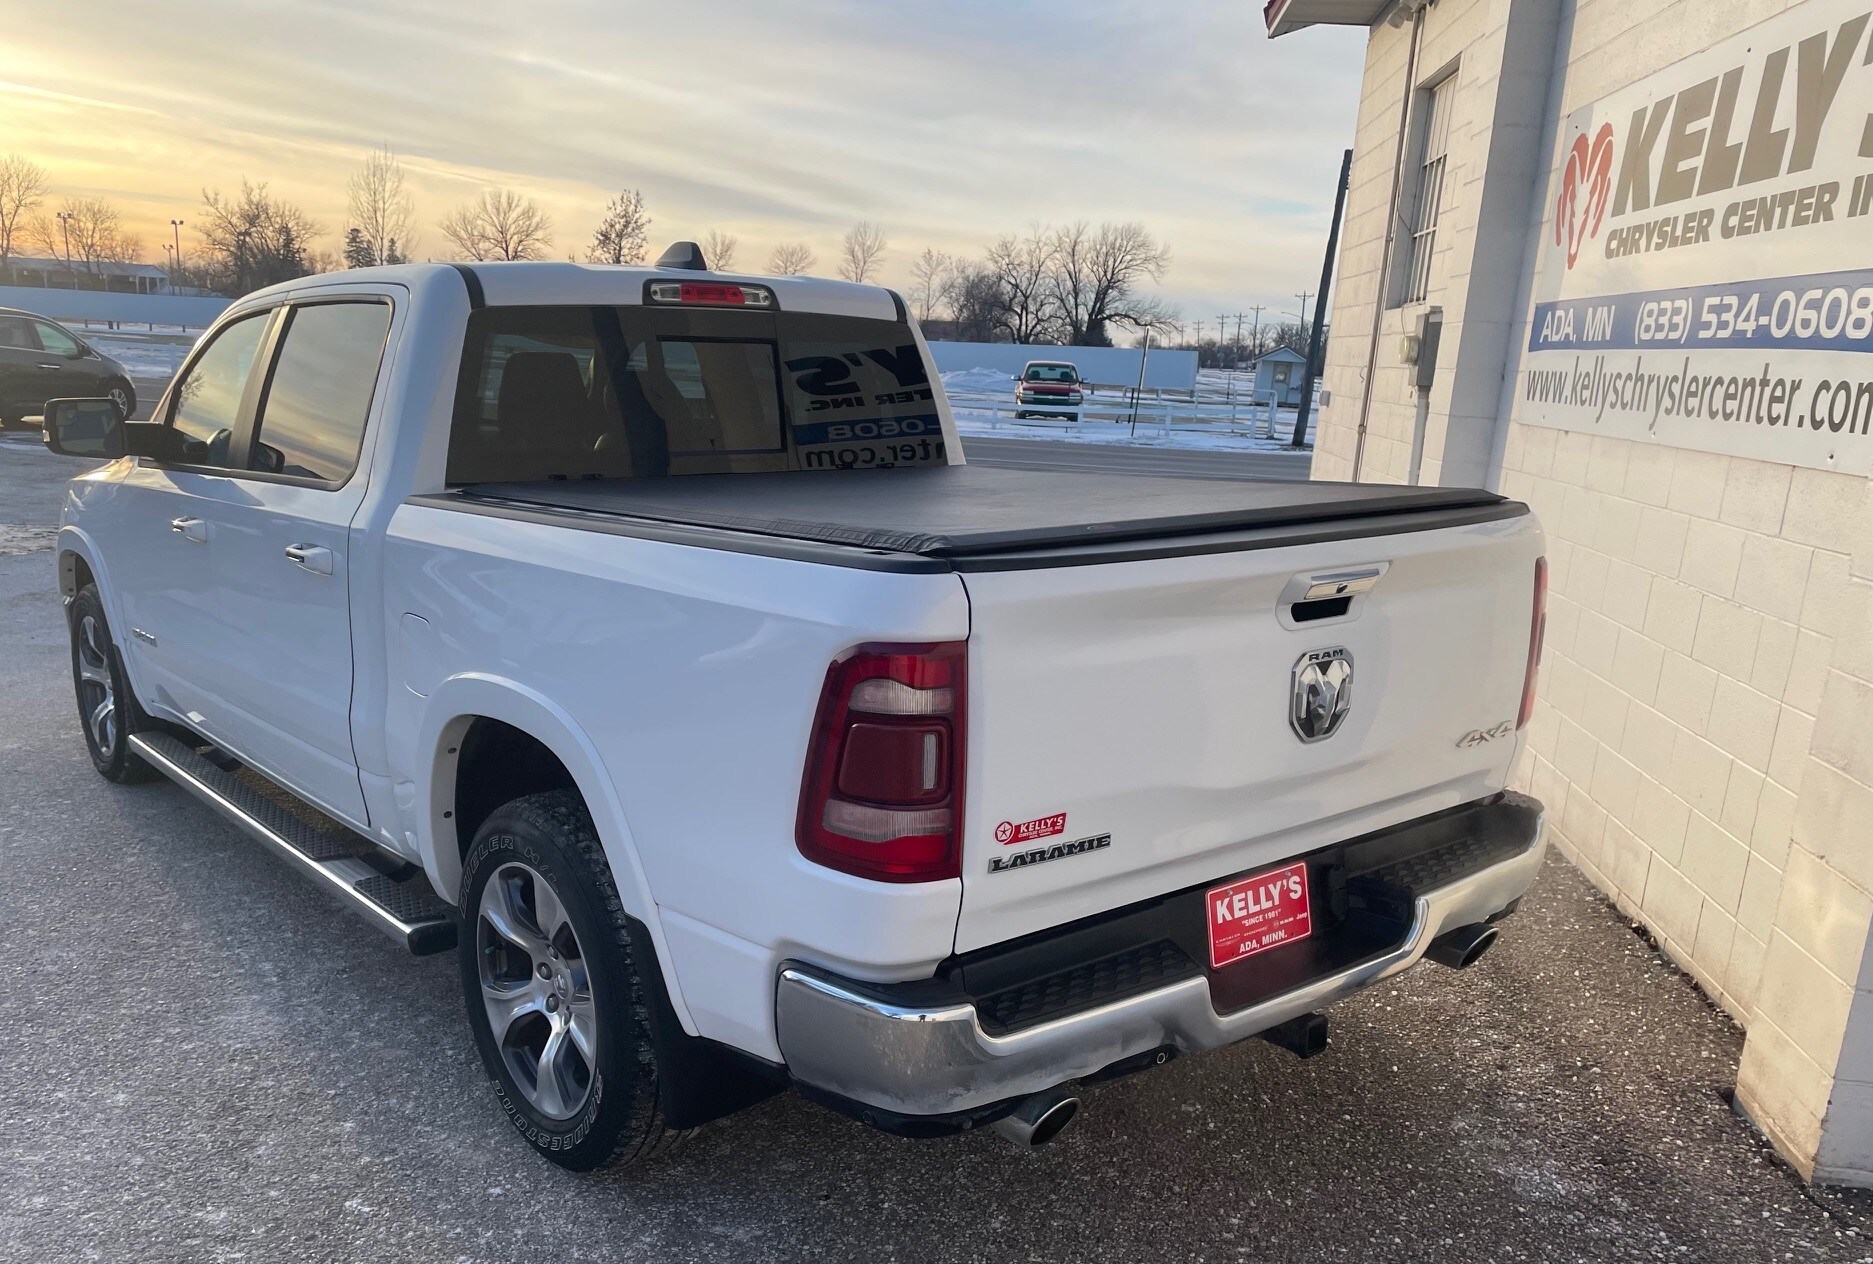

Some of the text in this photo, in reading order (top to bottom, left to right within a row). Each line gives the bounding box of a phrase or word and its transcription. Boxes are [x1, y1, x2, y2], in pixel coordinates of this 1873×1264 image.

[1611, 11, 1873, 217] KELLY
[1605, 208, 1714, 260] CHRYSLER
[1720, 181, 1840, 240] CENTER
[1539, 287, 1873, 345] ADA, MN (833) 534-0608
[1308, 648, 1344, 662] RAM
[1020, 816, 1064, 833] KELLY'S
[459, 835, 514, 920] DUELER
[989, 833, 1112, 874] LARAMIE
[1216, 875, 1303, 925] KELLY'S
[1239, 930, 1288, 954] ADA, MINN.
